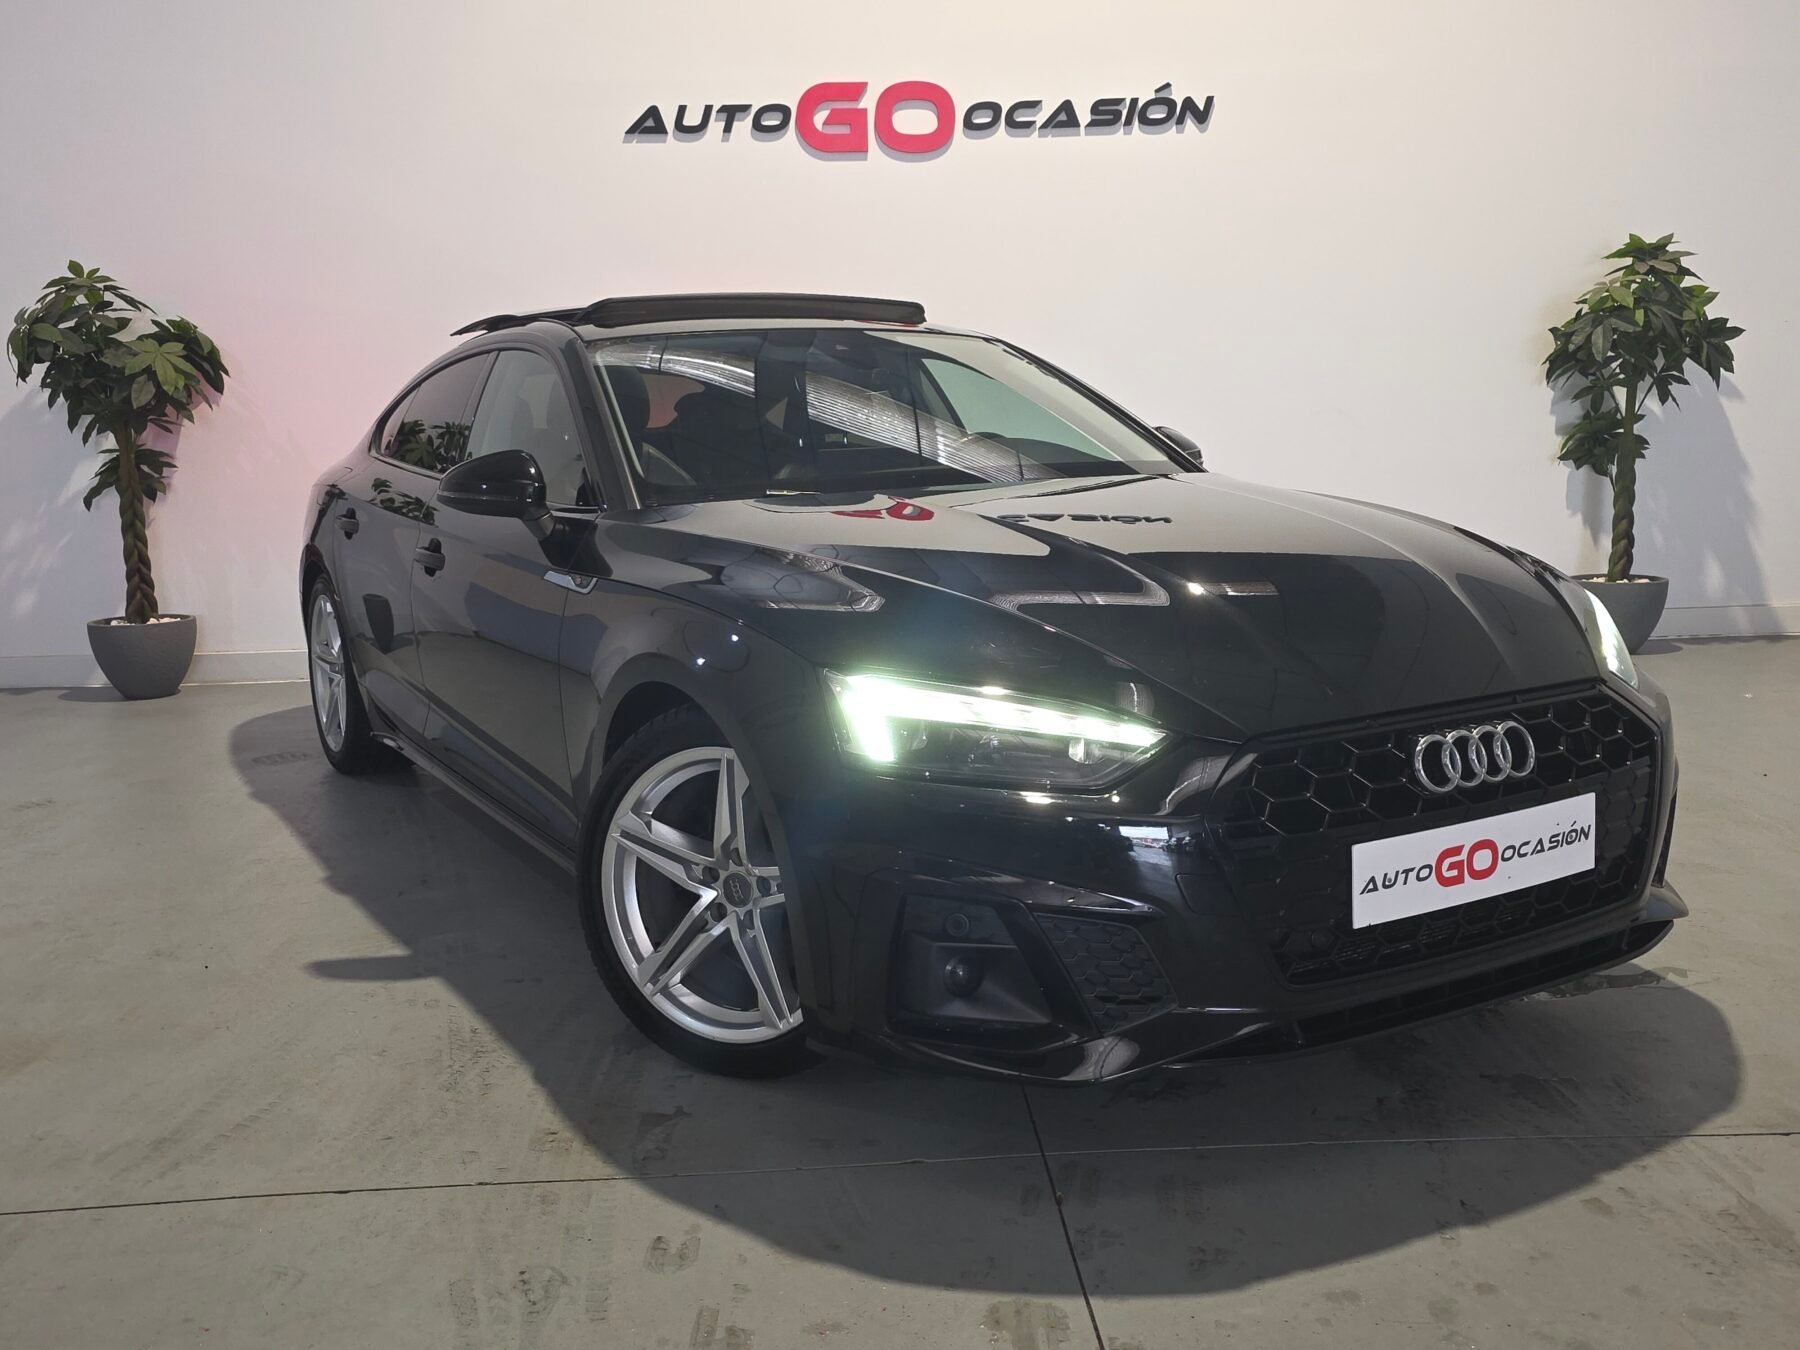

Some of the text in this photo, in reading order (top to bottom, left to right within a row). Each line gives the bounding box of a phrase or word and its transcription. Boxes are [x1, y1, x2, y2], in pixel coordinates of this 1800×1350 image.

[624, 103, 792, 138] AUTO
[795, 80, 956, 157] GO
[1359, 863, 1433, 895] AUTO
[1434, 838, 1499, 888] GO
